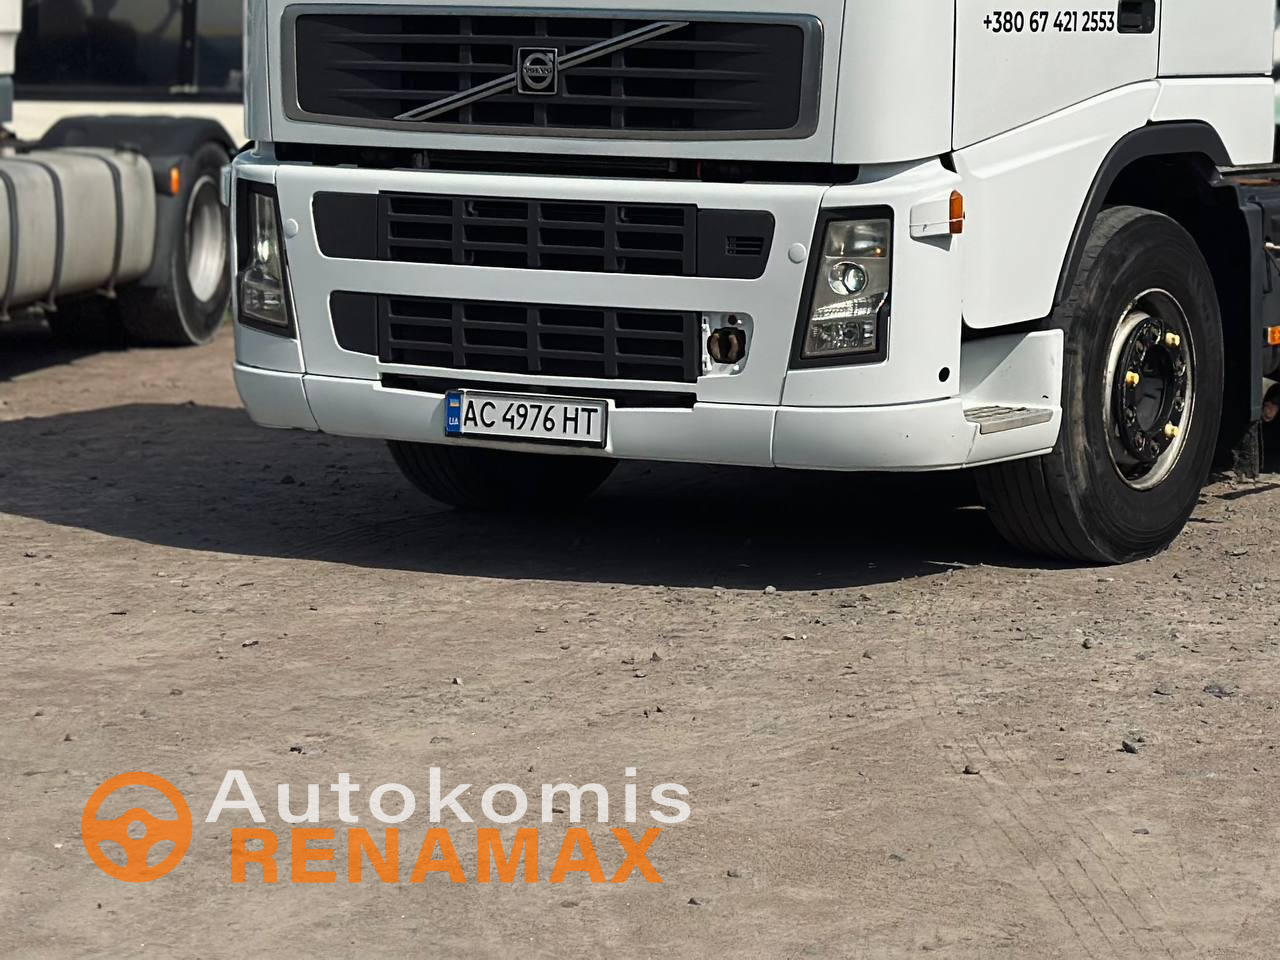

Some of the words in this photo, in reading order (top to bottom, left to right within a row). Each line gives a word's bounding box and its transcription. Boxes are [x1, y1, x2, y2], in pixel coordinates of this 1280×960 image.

[983, 10, 1025, 33] +380
[1029, 10, 1049, 33] 67
[1053, 10, 1078, 33] 421
[1081, 10, 1115, 33] 2553
[523, 66, 552, 75] VOLVO
[463, 399, 496, 429] AC
[502, 402, 556, 432] 4976
